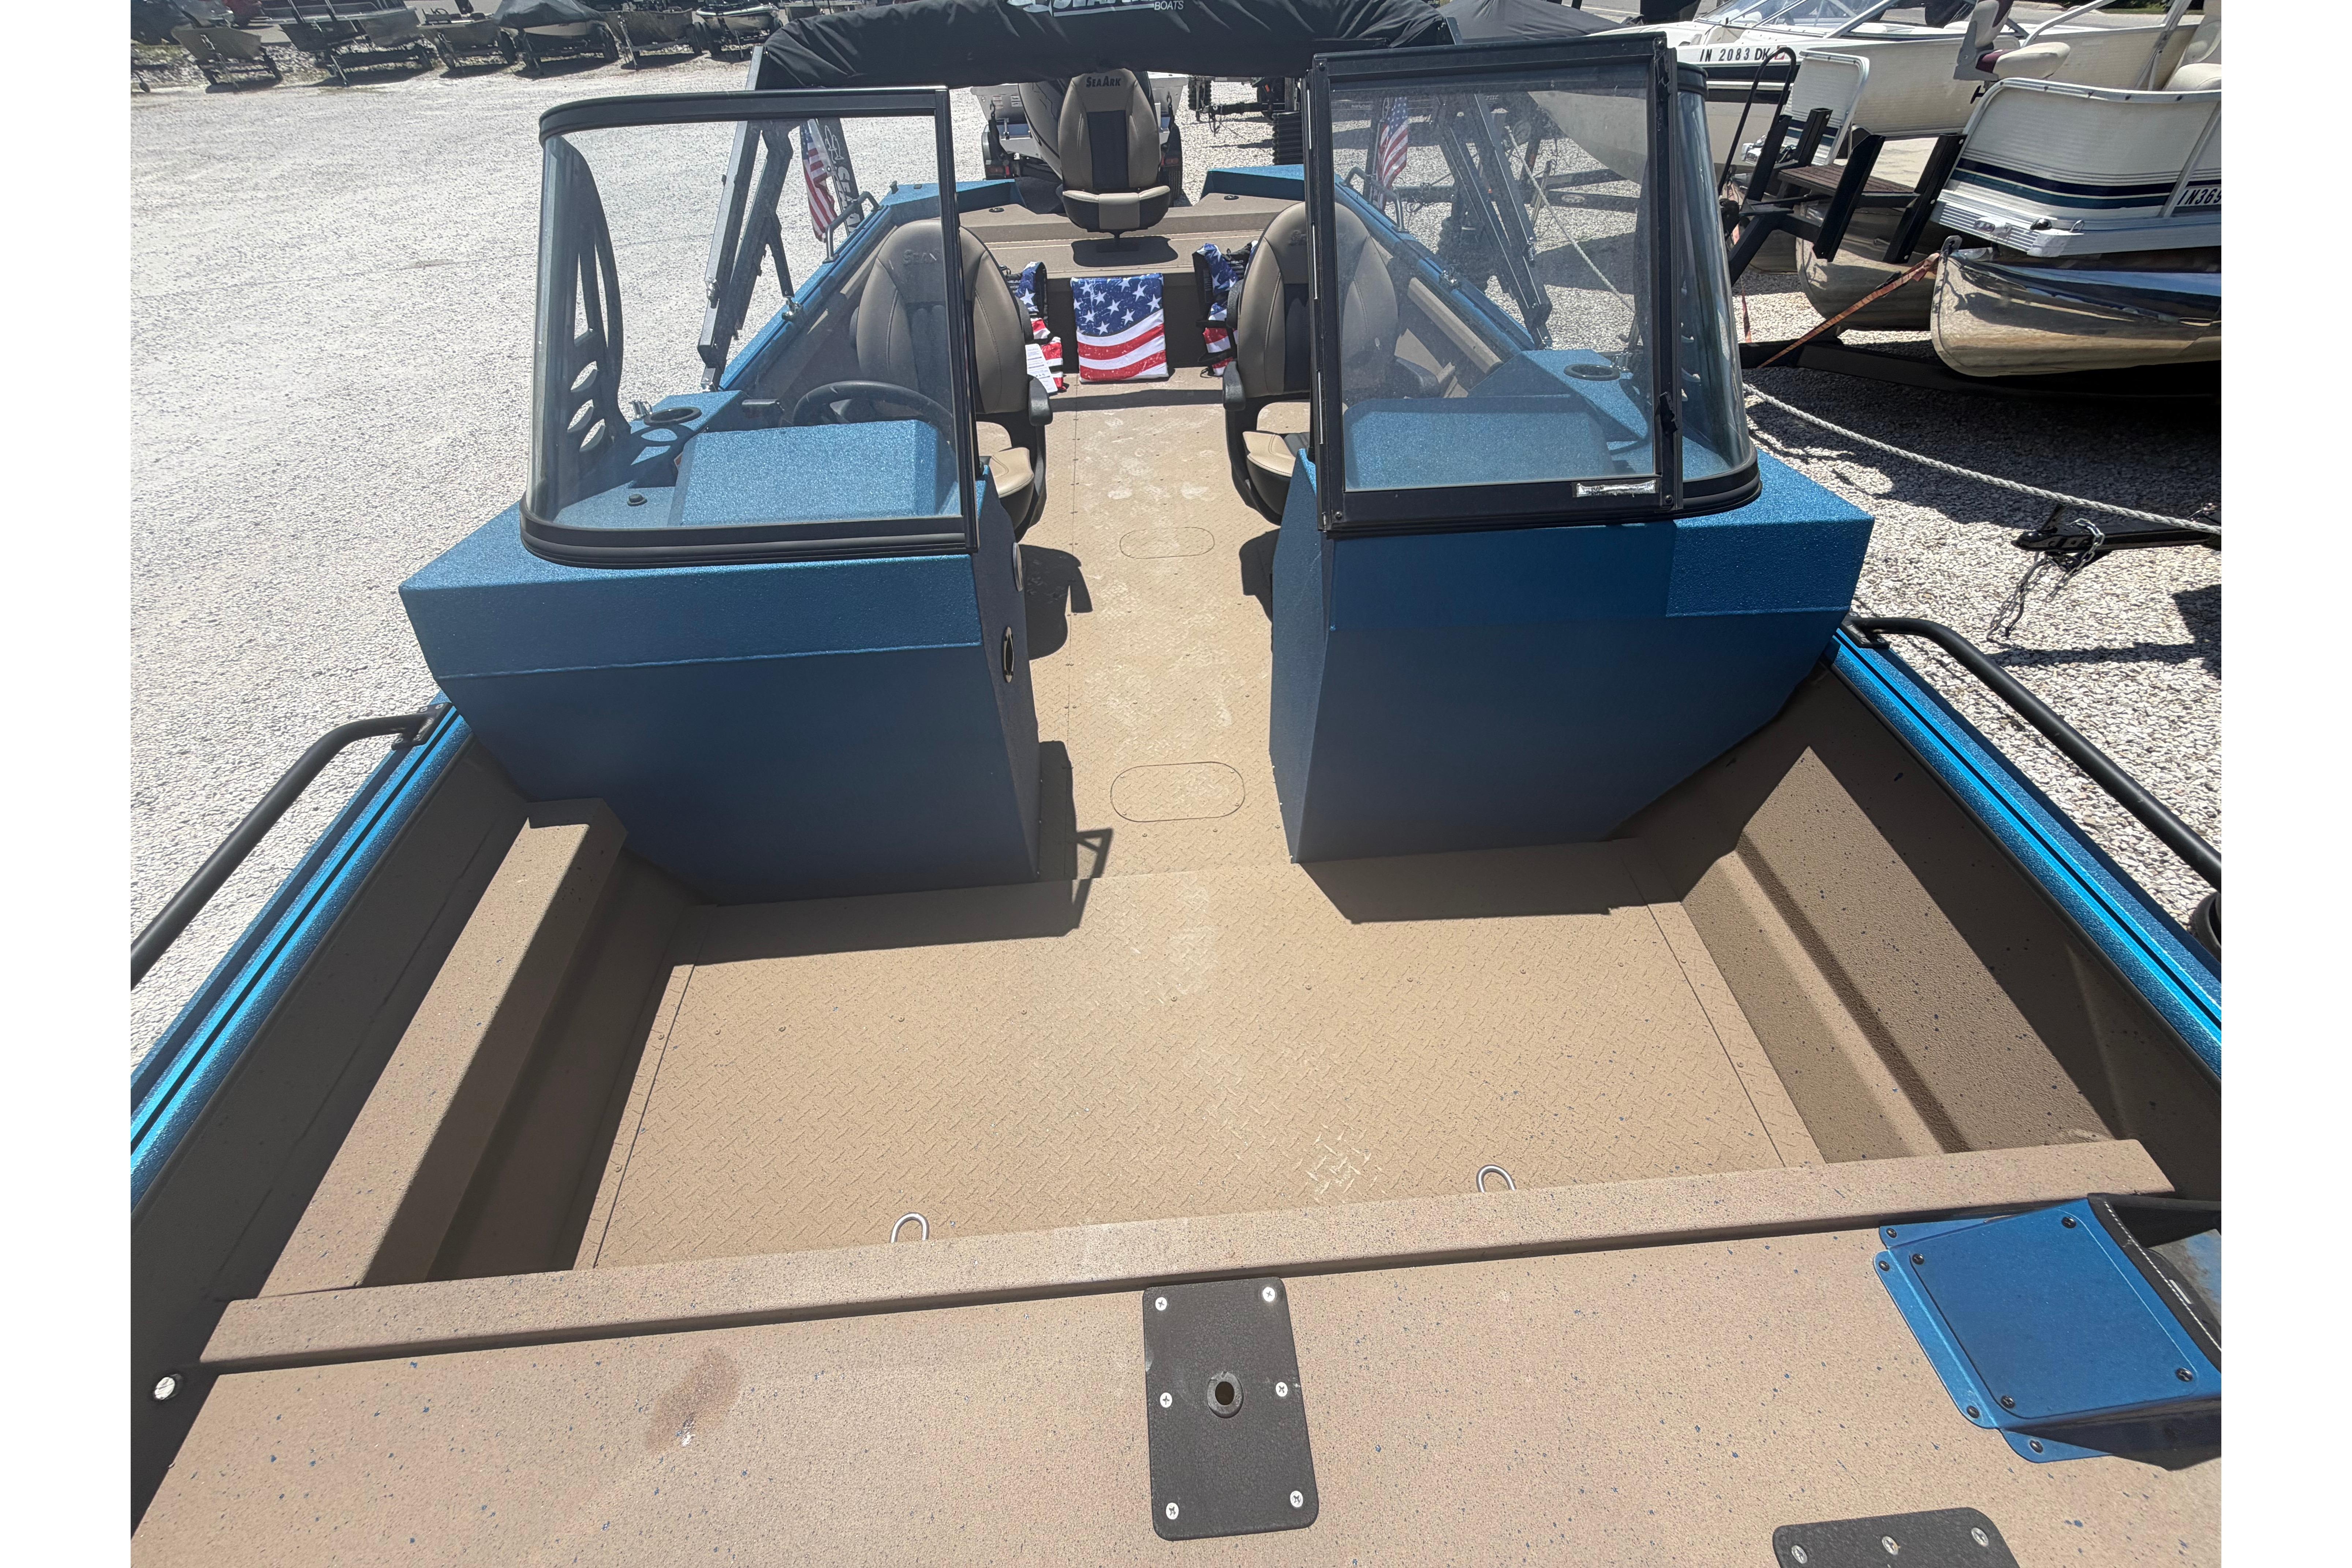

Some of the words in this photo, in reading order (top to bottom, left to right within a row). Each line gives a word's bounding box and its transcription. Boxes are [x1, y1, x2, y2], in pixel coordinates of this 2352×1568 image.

[1154, 1, 1184, 10] BOATS
[1699, 48, 1713, 62] IN
[1718, 48, 1750, 61] 2083
[1754, 48, 1771, 60] DK
